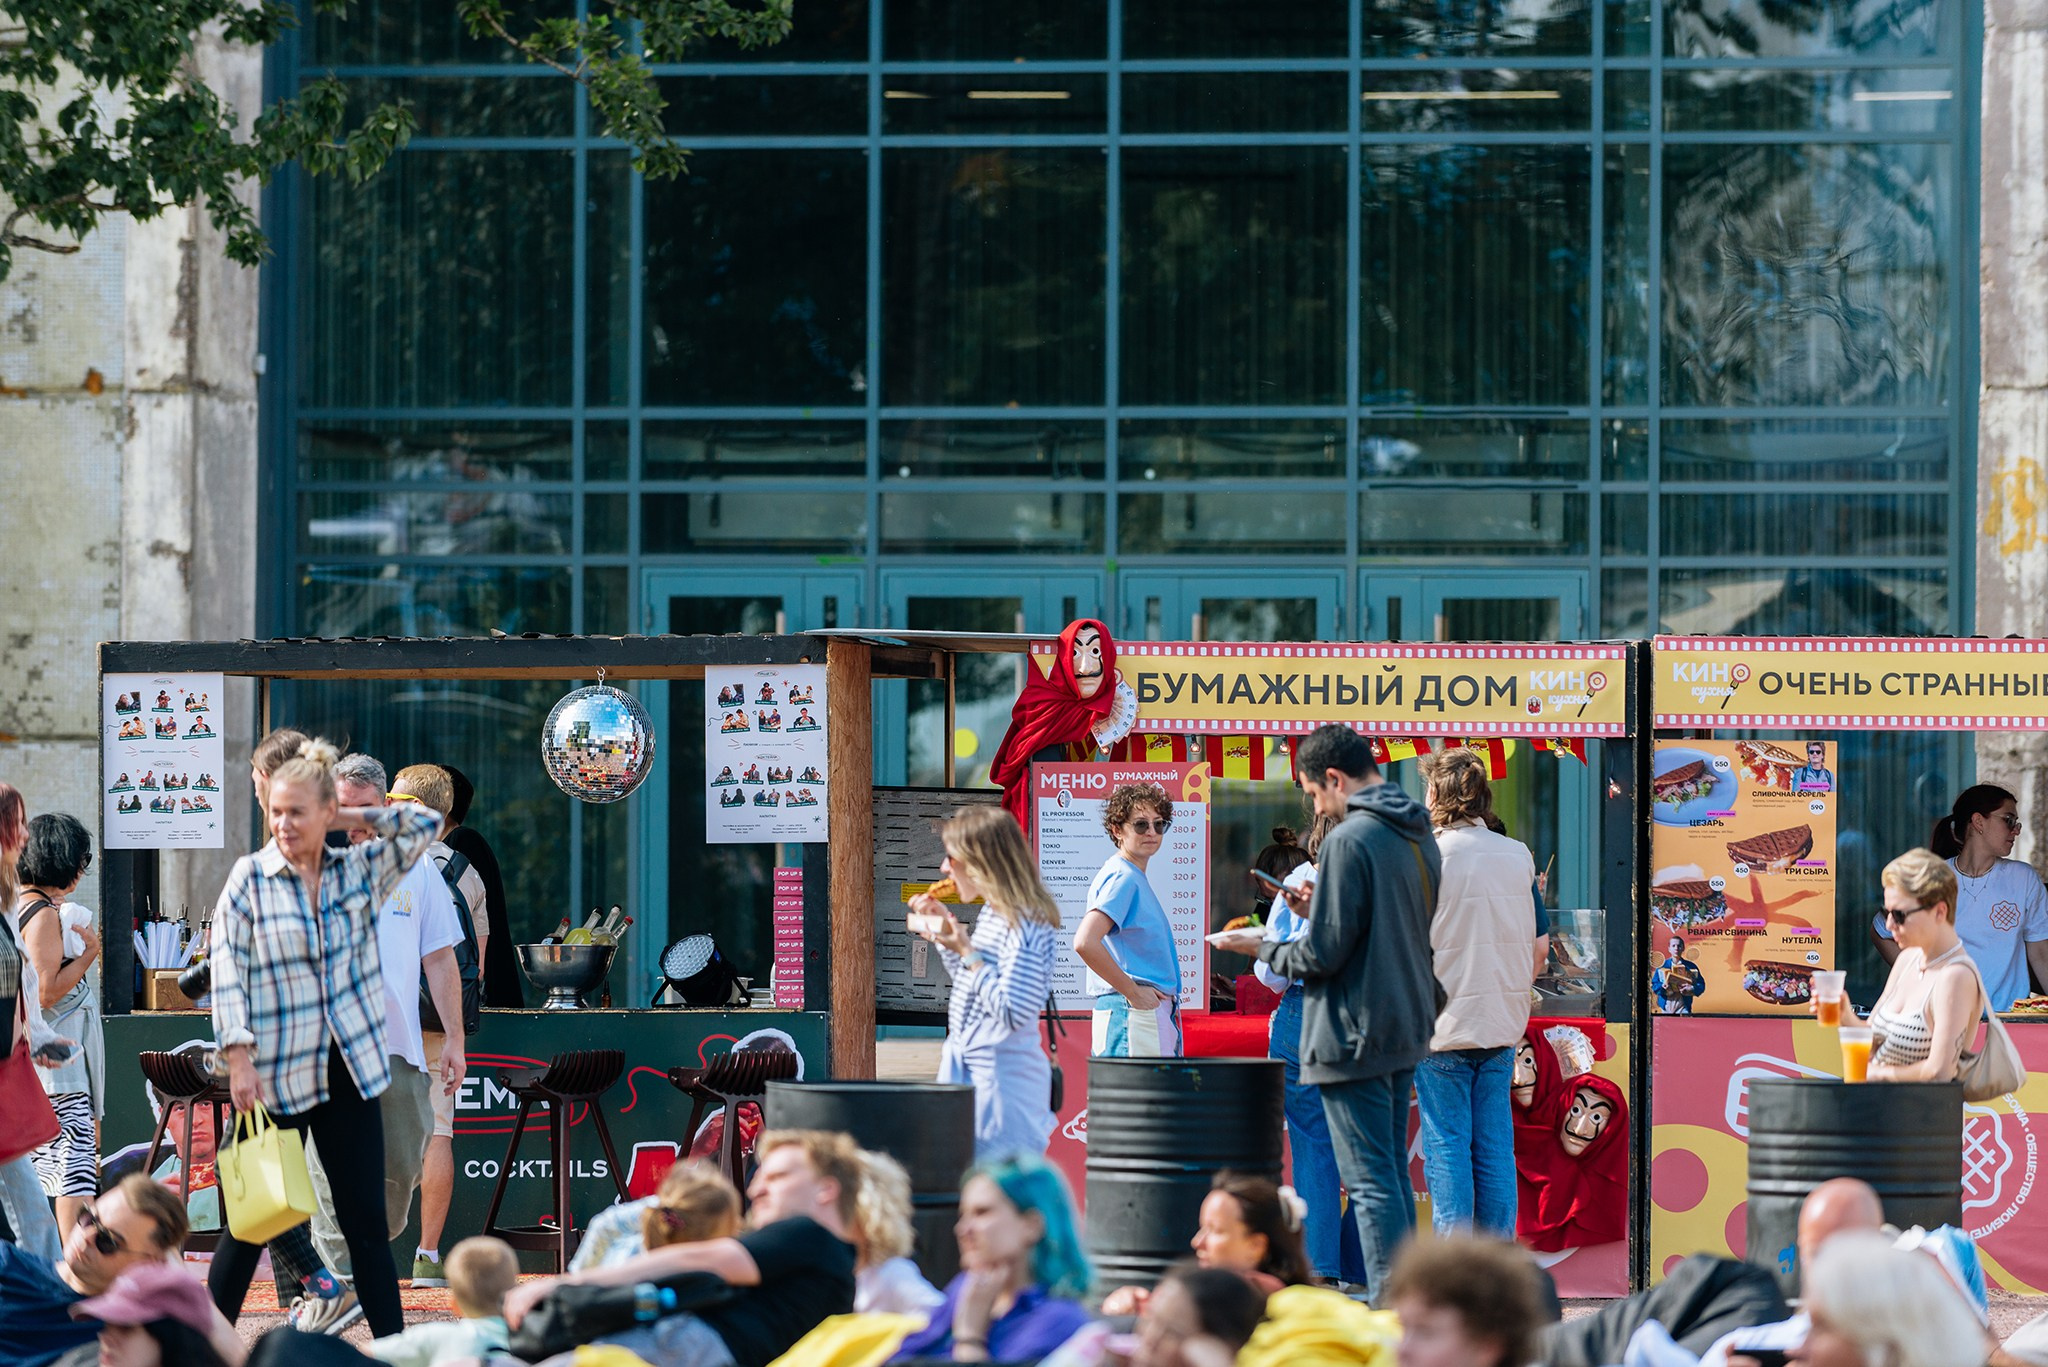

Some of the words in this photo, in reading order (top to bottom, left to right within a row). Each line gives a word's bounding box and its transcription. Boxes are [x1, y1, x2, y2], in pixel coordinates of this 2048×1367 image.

[1137, 664, 1402, 706] БУМАЖНЫЙ
[1414, 674, 1517, 712] ДОМ
[1758, 671, 1872, 696] ОЧЕНЬ
[1113, 769, 1178, 780] БУМАЖНЫЙ
[1041, 773, 1107, 789] МЕНЮ
[1797, 790, 1826, 798] ФОРЕЛЬ
[1689, 819, 1724, 828] ЦЕЗАРЬ
[1172, 873, 1189, 881] 320
[1172, 891, 1189, 899] 350
[1172, 907, 1189, 915] 290
[1688, 928, 1723, 936] РВАНАЯ
[1725, 928, 1768, 936] СВИНИНА
[1782, 937, 1823, 945] НУТЕЛЛА
[2002, 1092, 2030, 1128] SOWA
[464, 1160, 608, 1178] COKTILS
[2015, 1133, 2037, 1205] ОБЩЕСТВО
